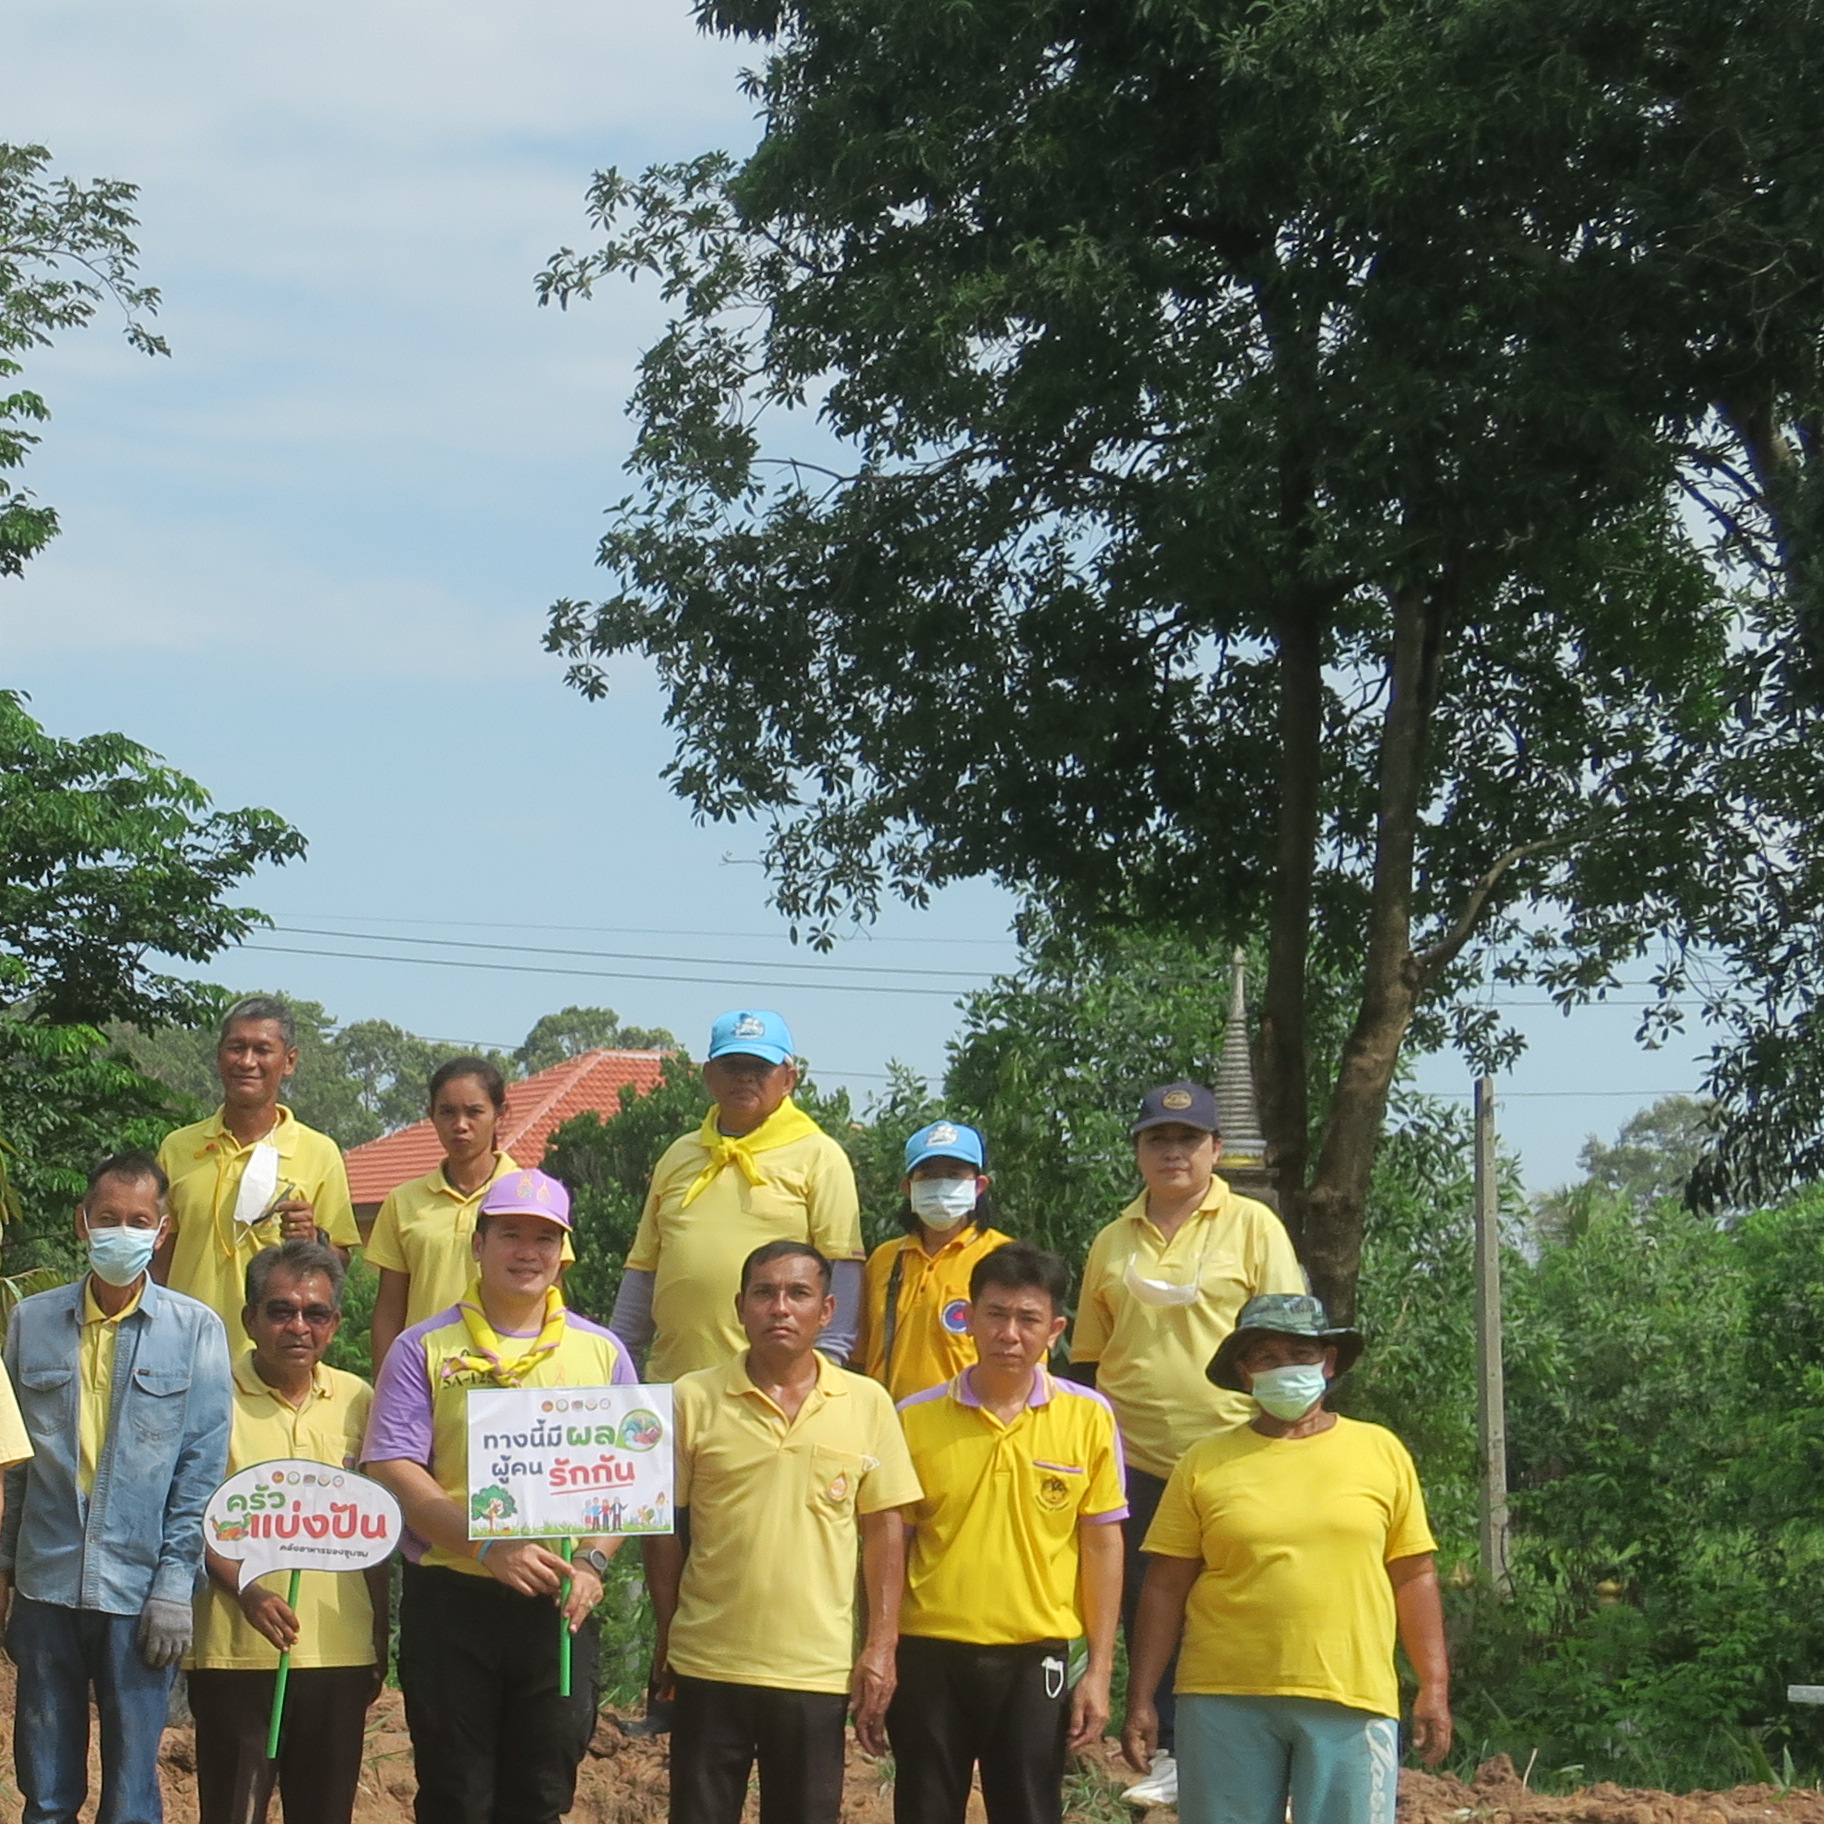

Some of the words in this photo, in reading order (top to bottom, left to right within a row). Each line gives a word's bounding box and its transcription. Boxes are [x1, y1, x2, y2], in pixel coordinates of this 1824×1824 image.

[566, 1425, 616, 1447] ผล
[492, 1454, 543, 1484] ผู้คน
[549, 1453, 636, 1487] รักกัน
[227, 1484, 286, 1512] ครัว
[251, 1500, 387, 1539] แบ่งปัน
